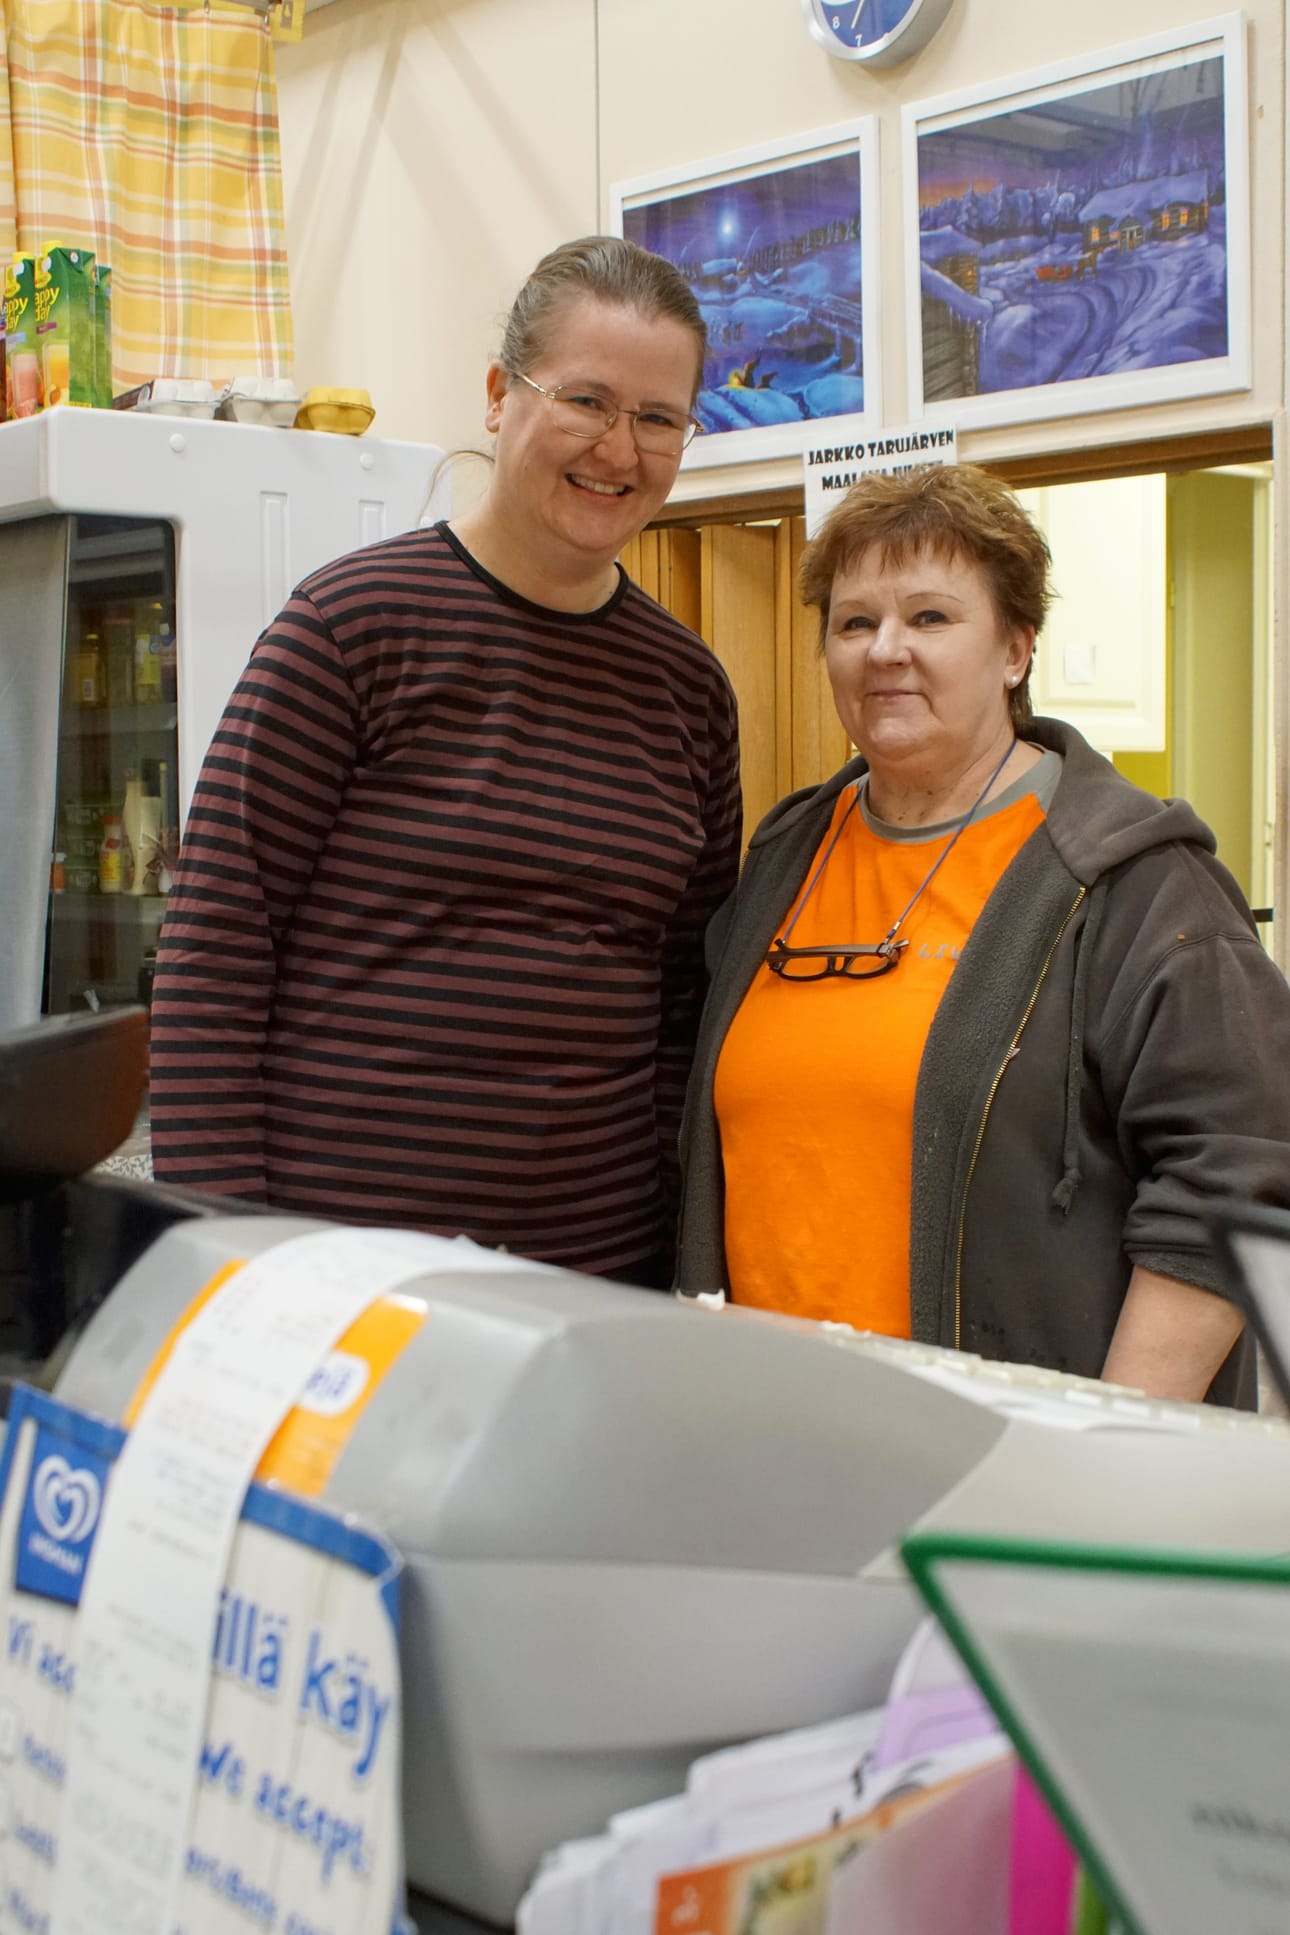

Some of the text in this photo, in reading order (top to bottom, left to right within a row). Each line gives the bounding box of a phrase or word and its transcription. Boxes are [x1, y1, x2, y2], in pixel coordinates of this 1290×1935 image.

[832, 15, 841, 30] 8
[855, 34, 863, 47] 7
[35, 287, 60, 308] appy
[808, 429, 954, 466] JARKKO TARUJÄRVEN
[213, 1587, 289, 1689] illä
[300, 1629, 391, 1780] käy
